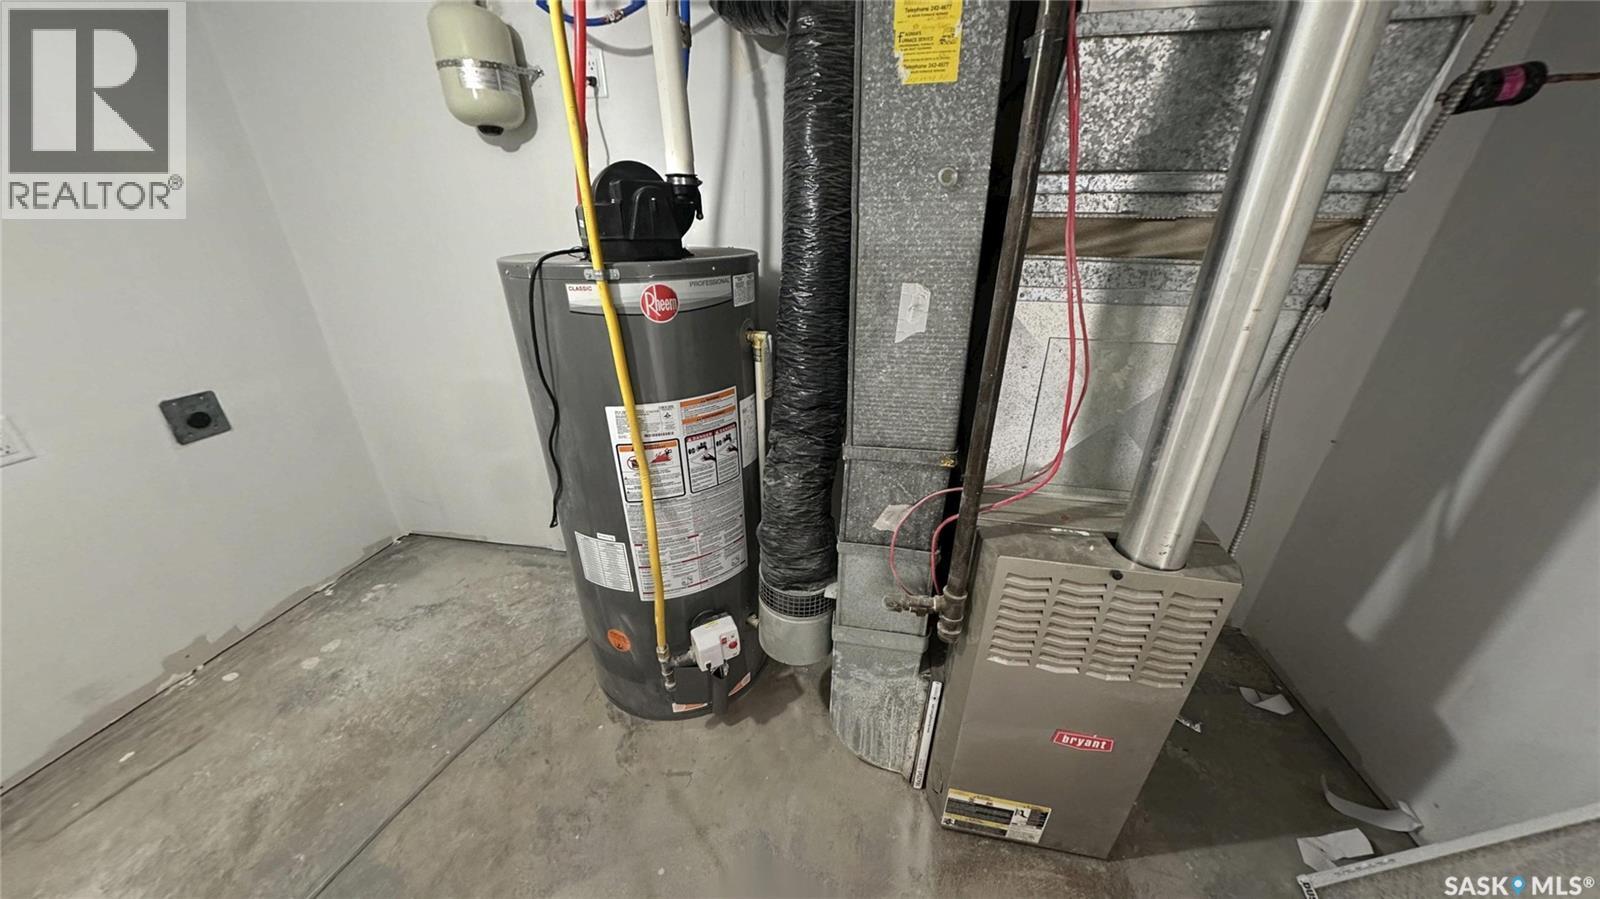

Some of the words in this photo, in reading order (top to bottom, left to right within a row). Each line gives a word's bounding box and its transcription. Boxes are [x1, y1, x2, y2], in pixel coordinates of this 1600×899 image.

[689, 278, 730, 288] PROFESSIONAL
[643, 285, 678, 317] Rheem
[1061, 734, 1107, 750] bryant
